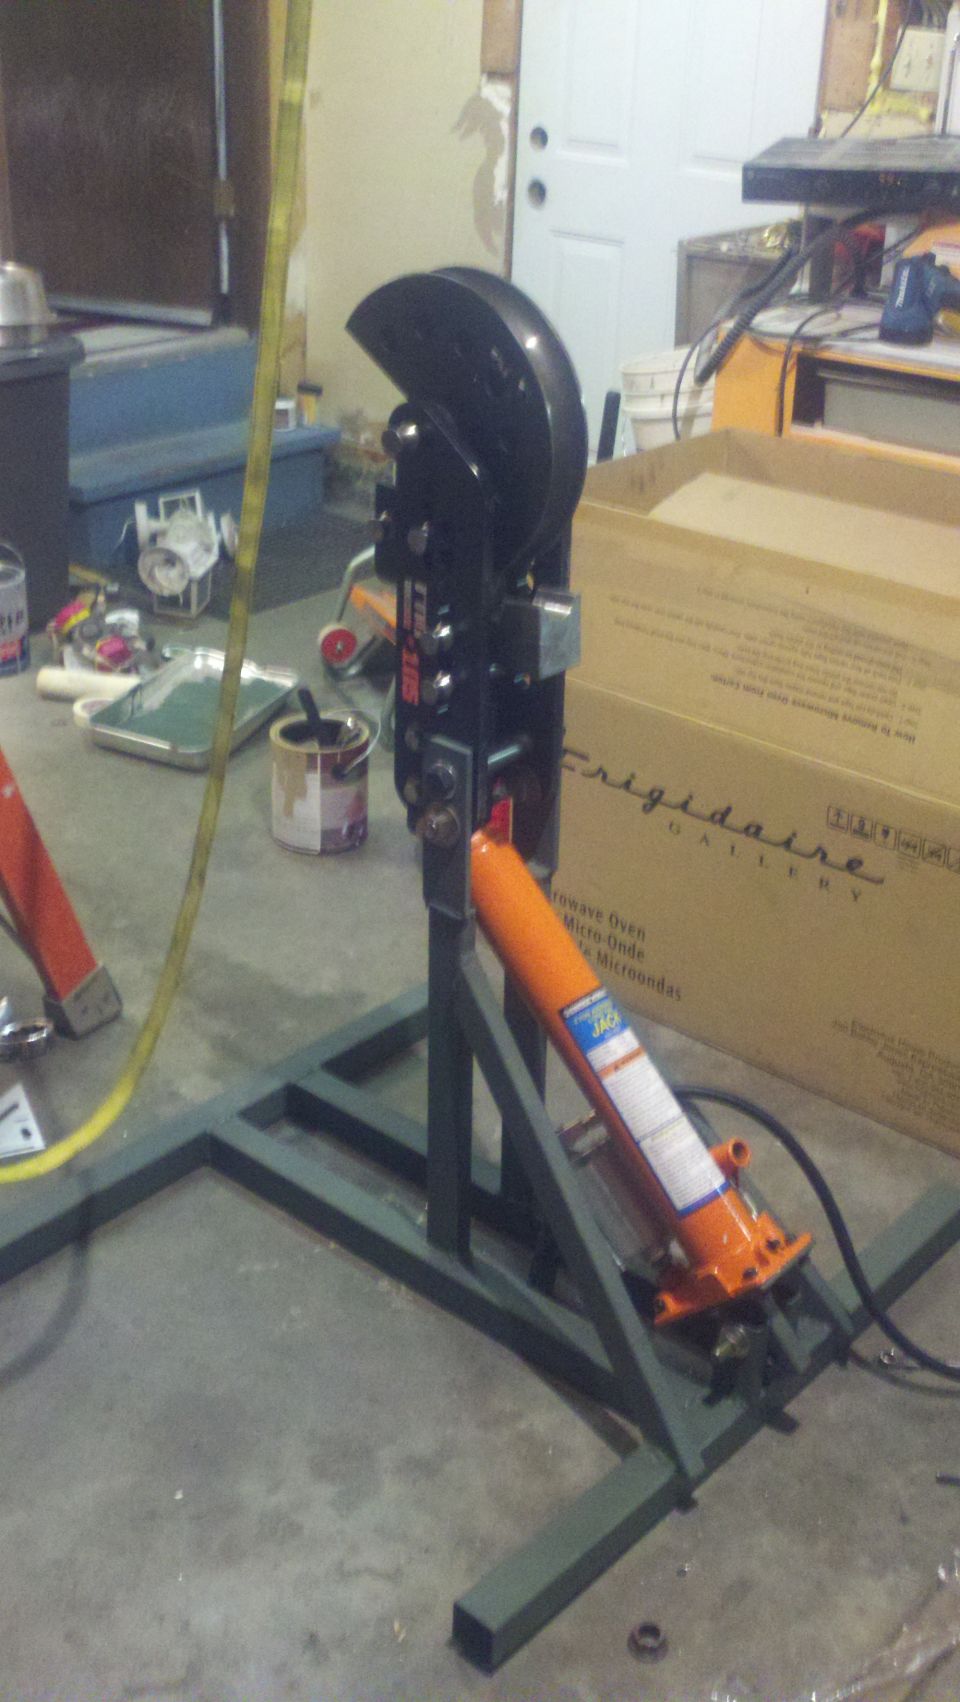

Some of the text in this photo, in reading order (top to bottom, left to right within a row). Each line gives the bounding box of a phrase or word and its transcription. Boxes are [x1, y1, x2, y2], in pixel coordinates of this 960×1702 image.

[668, 820, 863, 903] GALLERY
[553, 891, 646, 943] rowave Oven
[596, 950, 682, 1002] Microondas
